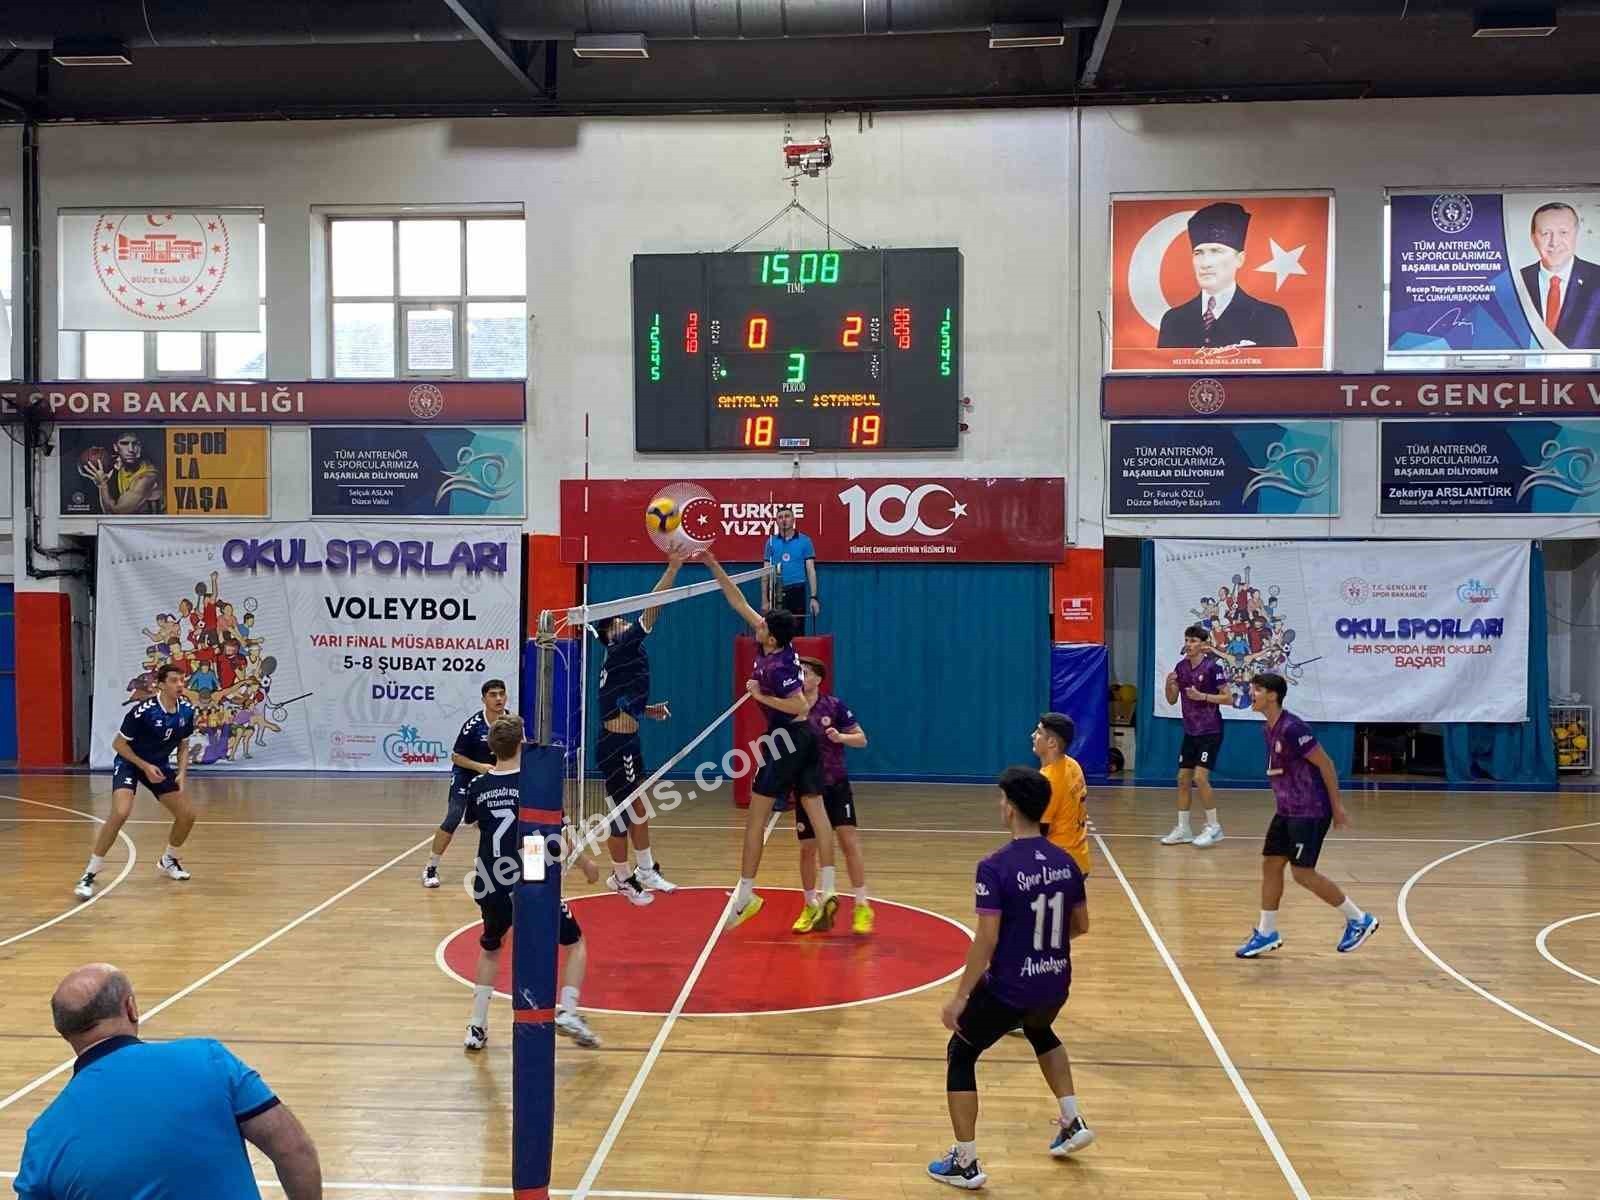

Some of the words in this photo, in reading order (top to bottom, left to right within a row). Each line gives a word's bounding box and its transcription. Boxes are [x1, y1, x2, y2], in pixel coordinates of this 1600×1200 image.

[1413, 240, 1435, 250] TÜM
[1438, 240, 1490, 250] ANTRENÖR
[1401, 251, 1414, 261] VE
[1416, 251, 1502, 260] SPORCULARIMIZA
[1401, 263, 1450, 273] BAŞARILAR
[1452, 262, 1501, 271] DİLİYORUM
[787, 282, 806, 293] TIME
[748, 318, 768, 348] 0
[843, 316, 862, 347] 2
[787, 353, 805, 383] 3
[782, 382, 806, 392] PERIOD
[1340, 384, 1402, 407] T.C.
[1417, 378, 1575, 409] GENÇLİK
[123, 387, 304, 413] BAKANLIĞI
[718, 394, 779, 408] ANTALYA
[744, 415, 774, 446] 18
[851, 415, 880, 445] 19
[173, 431, 227, 454] SPOR
[1407, 444, 1429, 455] TÜM
[1432, 444, 1487, 454] ANTRENÖR
[336, 450, 355, 459] TÜM
[357, 449, 408, 459] ANTRENÖR
[1135, 446, 1157, 456] TÜM
[1160, 446, 1214, 456] ANTRENÖR
[323, 461, 336, 469] VE
[337, 461, 419, 469] SPORCULARIMIZA
[1123, 458, 1136, 466] VE
[1137, 457, 1225, 466] SPORCULARIMIZA
[1394, 456, 1407, 465] VE
[1410, 455, 1500, 464] SPORCULARIMIZA
[175, 457, 200, 480] LA
[323, 471, 370, 480] BAŞARILAR
[371, 470, 419, 479] DİLİYORUM
[1122, 469, 1172, 479] BAŞARILAR
[1174, 468, 1225, 477] DİLİYORUM
[1394, 468, 1445, 477] BAŞARILAR
[1447, 466, 1498, 475] DİLİYORUM
[174, 486, 228, 512] YAŞA
[1143, 490, 1155, 498] Dr.
[1156, 490, 1180, 498] Faruk
[1389, 487, 1434, 500] Zekeriya
[1436, 484, 1512, 497] ARSLANTÜRK
[1153, 498, 1188, 508] Belediye
[1189, 498, 1221, 508] Başkanı
[222, 538, 323, 572] OKUL
[325, 538, 508, 578] SPORLARI
[324, 596, 477, 621] VOLEYBOL
[1335, 617, 1396, 640] OKUL
[1398, 616, 1505, 641] SPORLARI
[309, 634, 342, 647] YARI
[391, 634, 510, 651] MÜSABAKALARI
[1348, 645, 1372, 654] HEM
[1374, 644, 1419, 655] SPORDA
[1422, 645, 1446, 655] HEM
[1448, 644, 1492, 655] OKULDA
[343, 655, 373, 670] 5-8
[378, 656, 437, 675] ŞUBAT
[442, 658, 486, 672] 2026
[1395, 656, 1446, 670] BAŞARI
[372, 681, 435, 701] DÜZCE
[1201, 751, 1209, 763] 8
[845, 803, 851, 818] 1
[490, 808, 516, 857] 7
[1295, 843, 1304, 859] 7
[1030, 890, 1064, 951] 11
